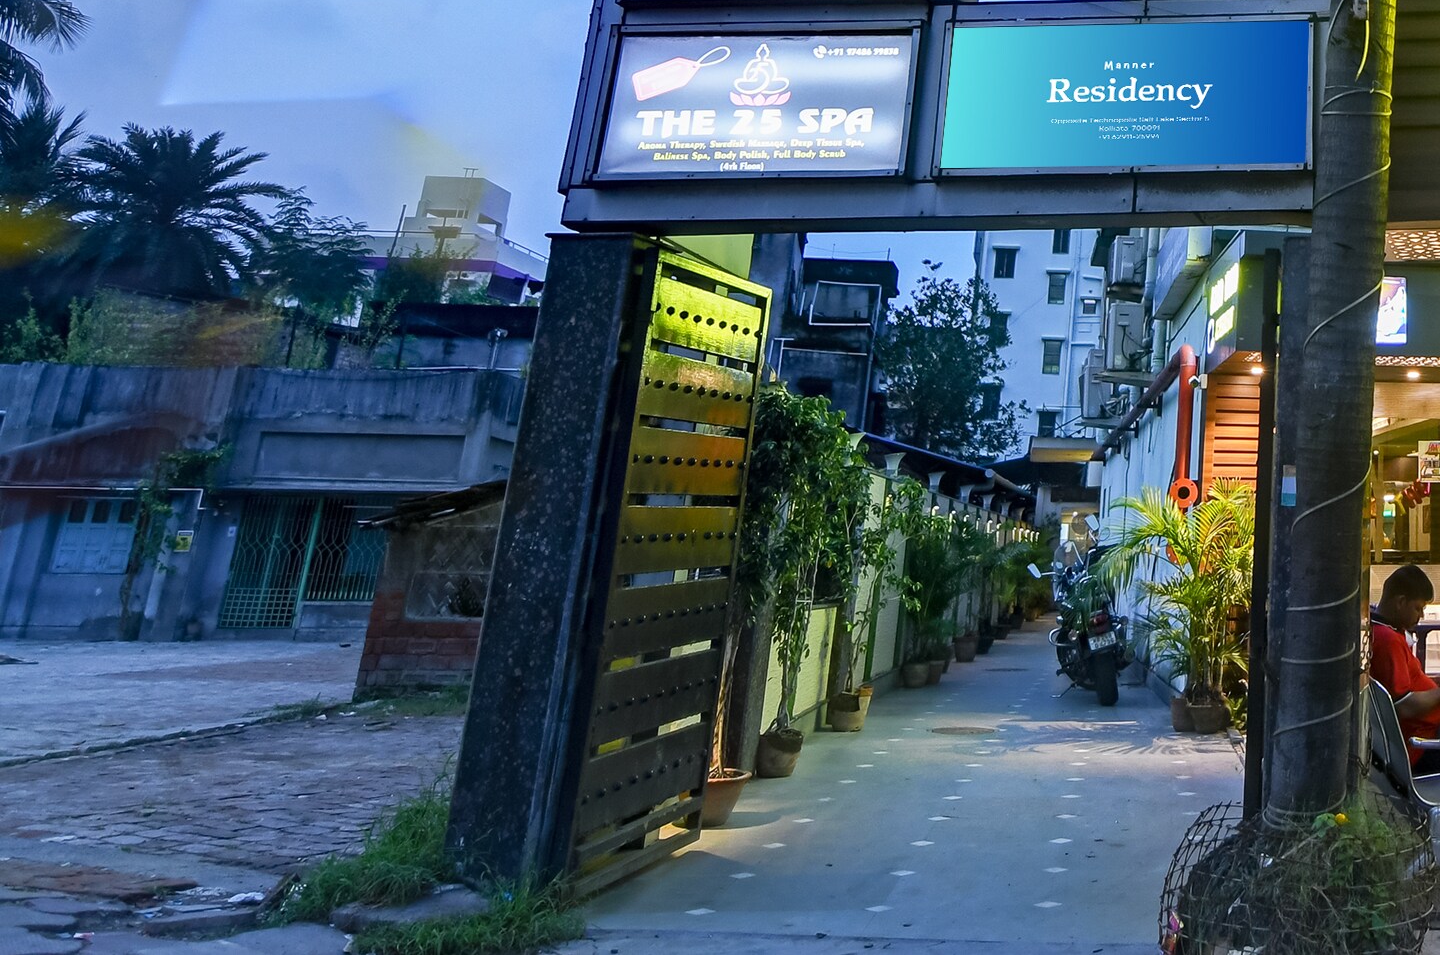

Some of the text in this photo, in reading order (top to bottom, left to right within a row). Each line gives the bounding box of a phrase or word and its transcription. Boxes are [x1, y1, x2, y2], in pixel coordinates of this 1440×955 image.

[1104, 60, 1155, 71] Manner
[1046, 77, 1213, 110] Residency
[636, 108, 874, 138] THE 25 SPA
